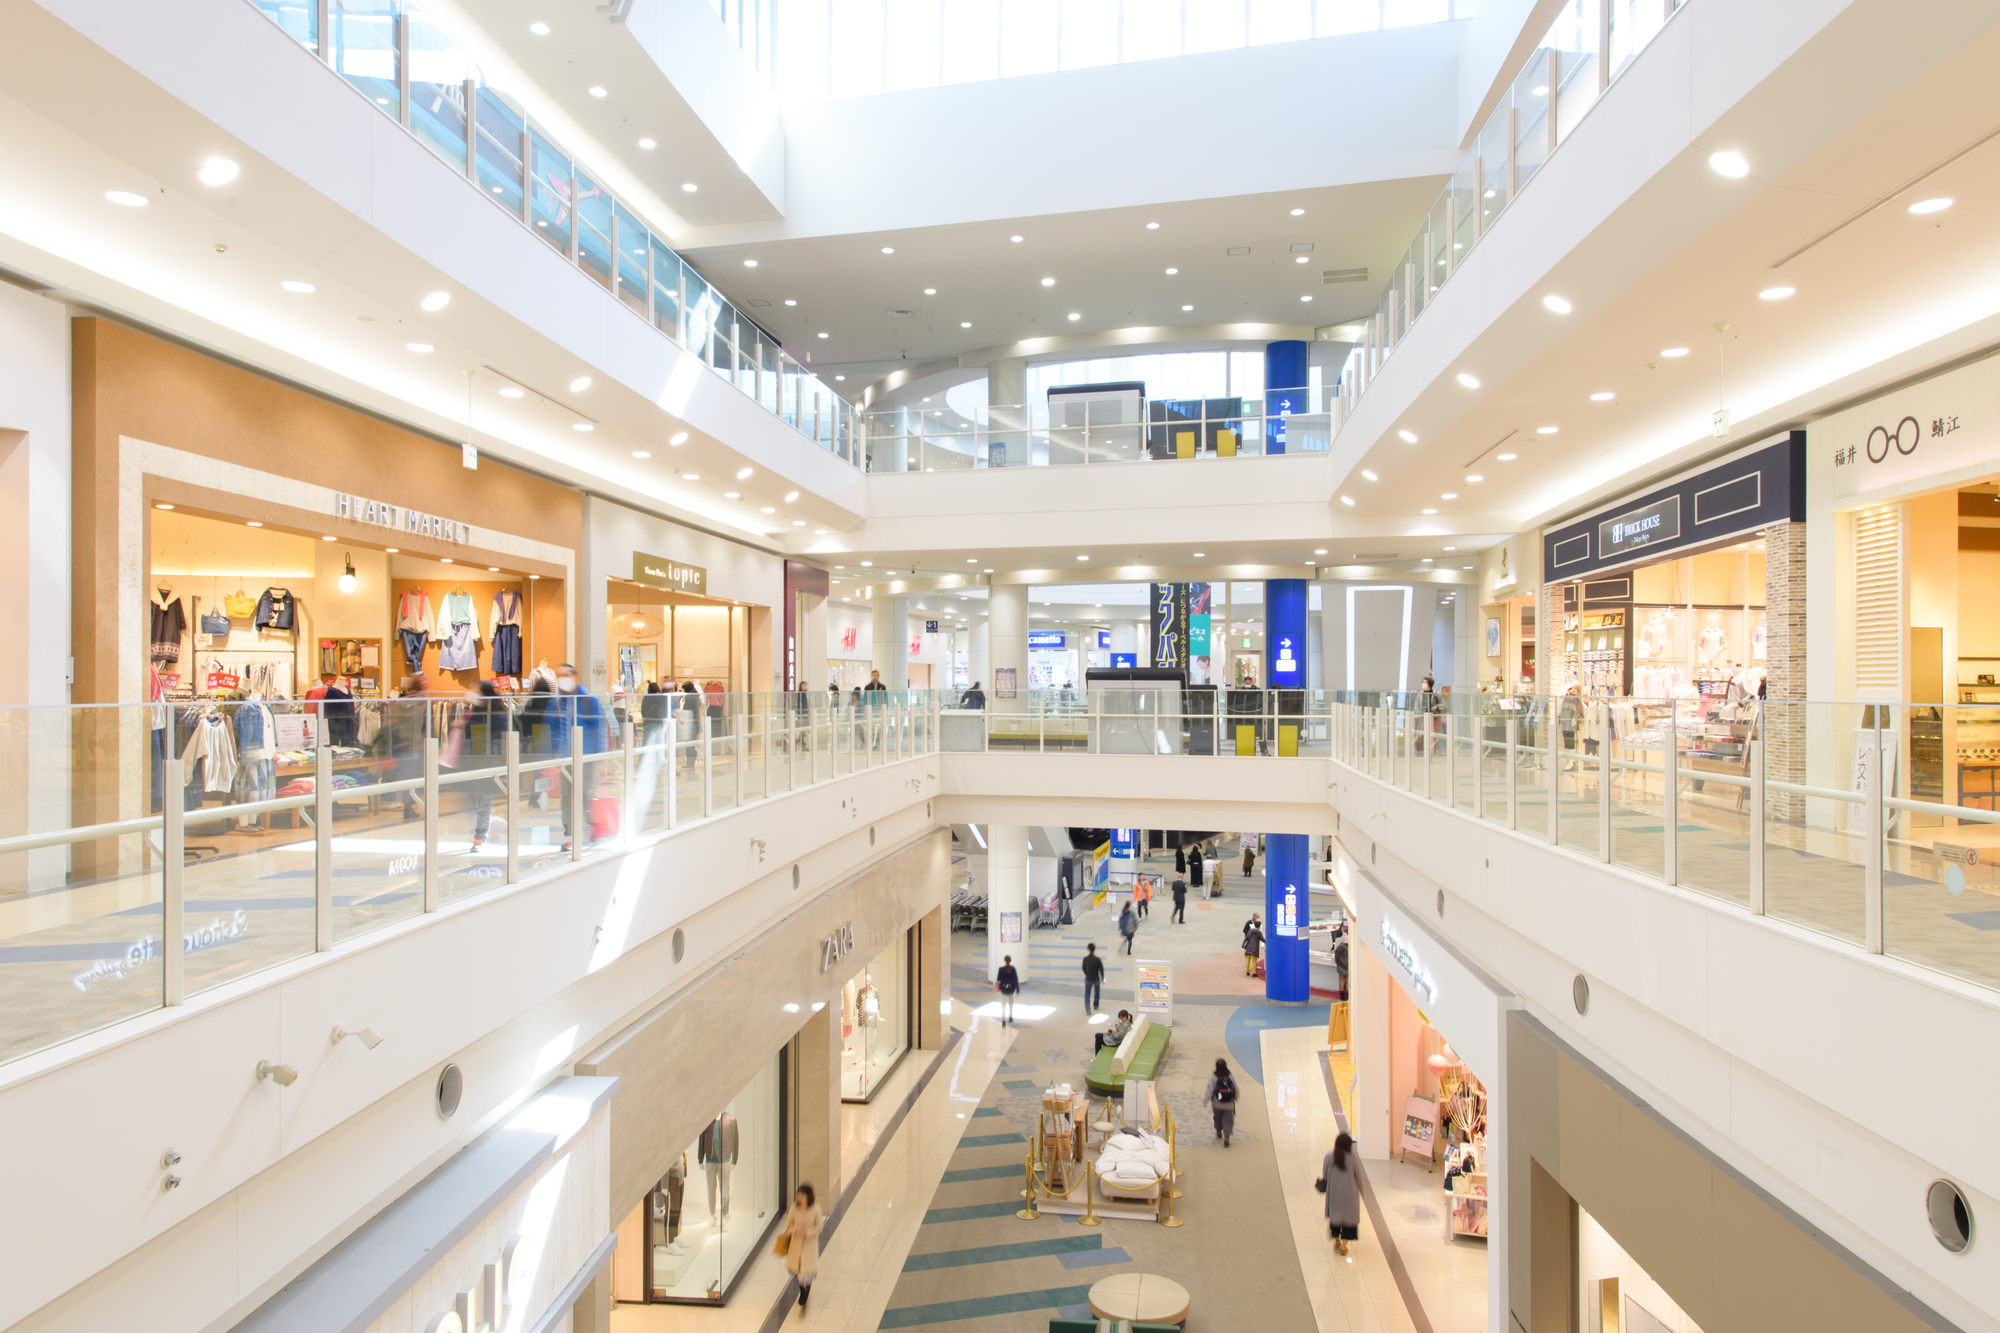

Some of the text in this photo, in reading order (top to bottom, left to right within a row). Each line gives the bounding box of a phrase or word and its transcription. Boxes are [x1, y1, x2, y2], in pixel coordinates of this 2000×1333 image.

[1931, 416, 1960, 438] 鯖江
[1834, 444, 1857, 467] 福井
[338, 492, 474, 543] HEART MARKET
[1624, 520, 1641, 537] BRICK
[1641, 513, 1661, 531] HOUSE
[668, 562, 701, 588] topic
[1154, 584, 1178, 668] ックパ
[822, 922, 855, 972] ZARA
